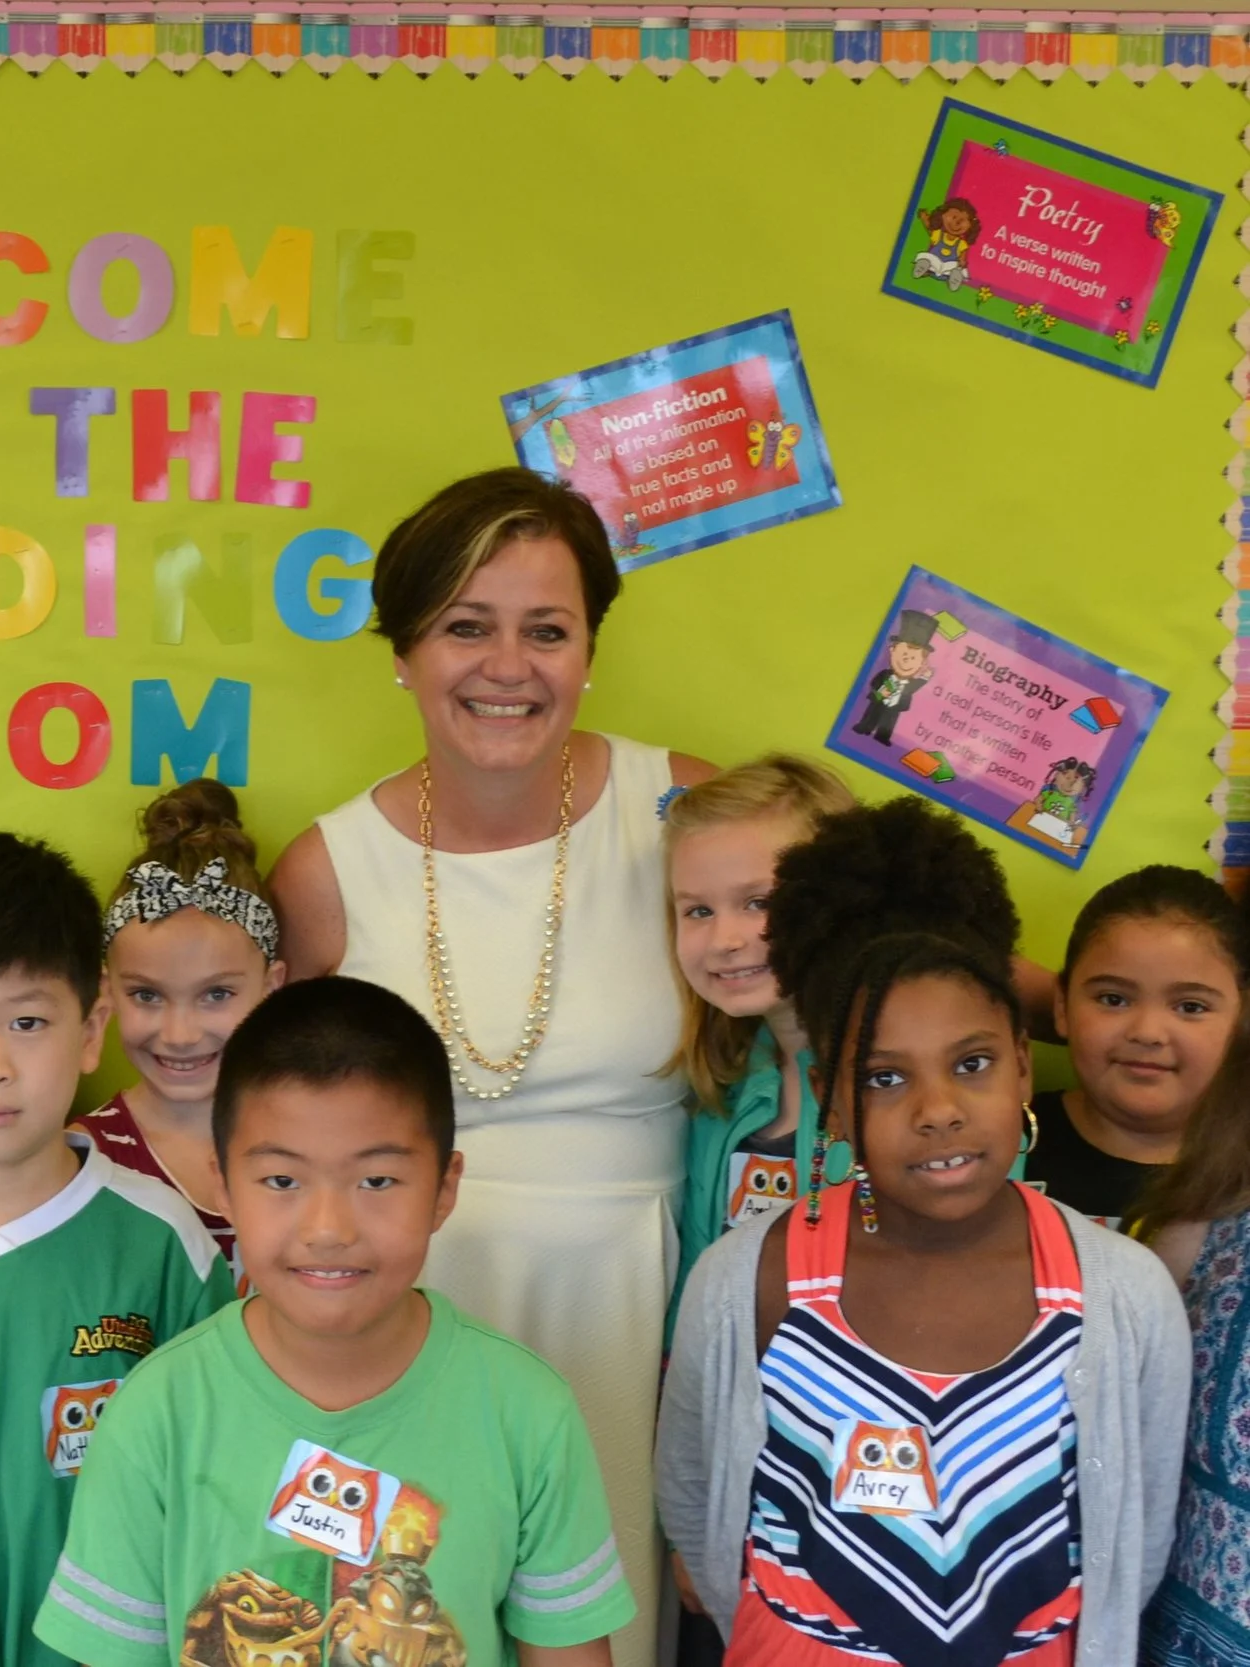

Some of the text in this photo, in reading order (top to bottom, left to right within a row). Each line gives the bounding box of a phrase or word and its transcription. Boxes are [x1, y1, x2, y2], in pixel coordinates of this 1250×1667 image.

[1018, 185, 1104, 246] Poetry
[981, 244, 1107, 299] to inspire thought
[994, 226, 1101, 273] A verse written
[594, 406, 746, 463] All of the information
[601, 387, 728, 436] Non-fiction
[29, 386, 316, 508] THE
[632, 438, 718, 473] is based on
[630, 454, 732, 498] true facts and
[642, 479, 737, 517] not made up
[961, 646, 1070, 710] Biography
[965, 674, 1043, 721] The story of
[933, 685, 1052, 750] a real person's life
[938, 710, 1027, 763] that is written
[914, 722, 1035, 791] by another person
[291, 1503, 345, 1540] Justin
